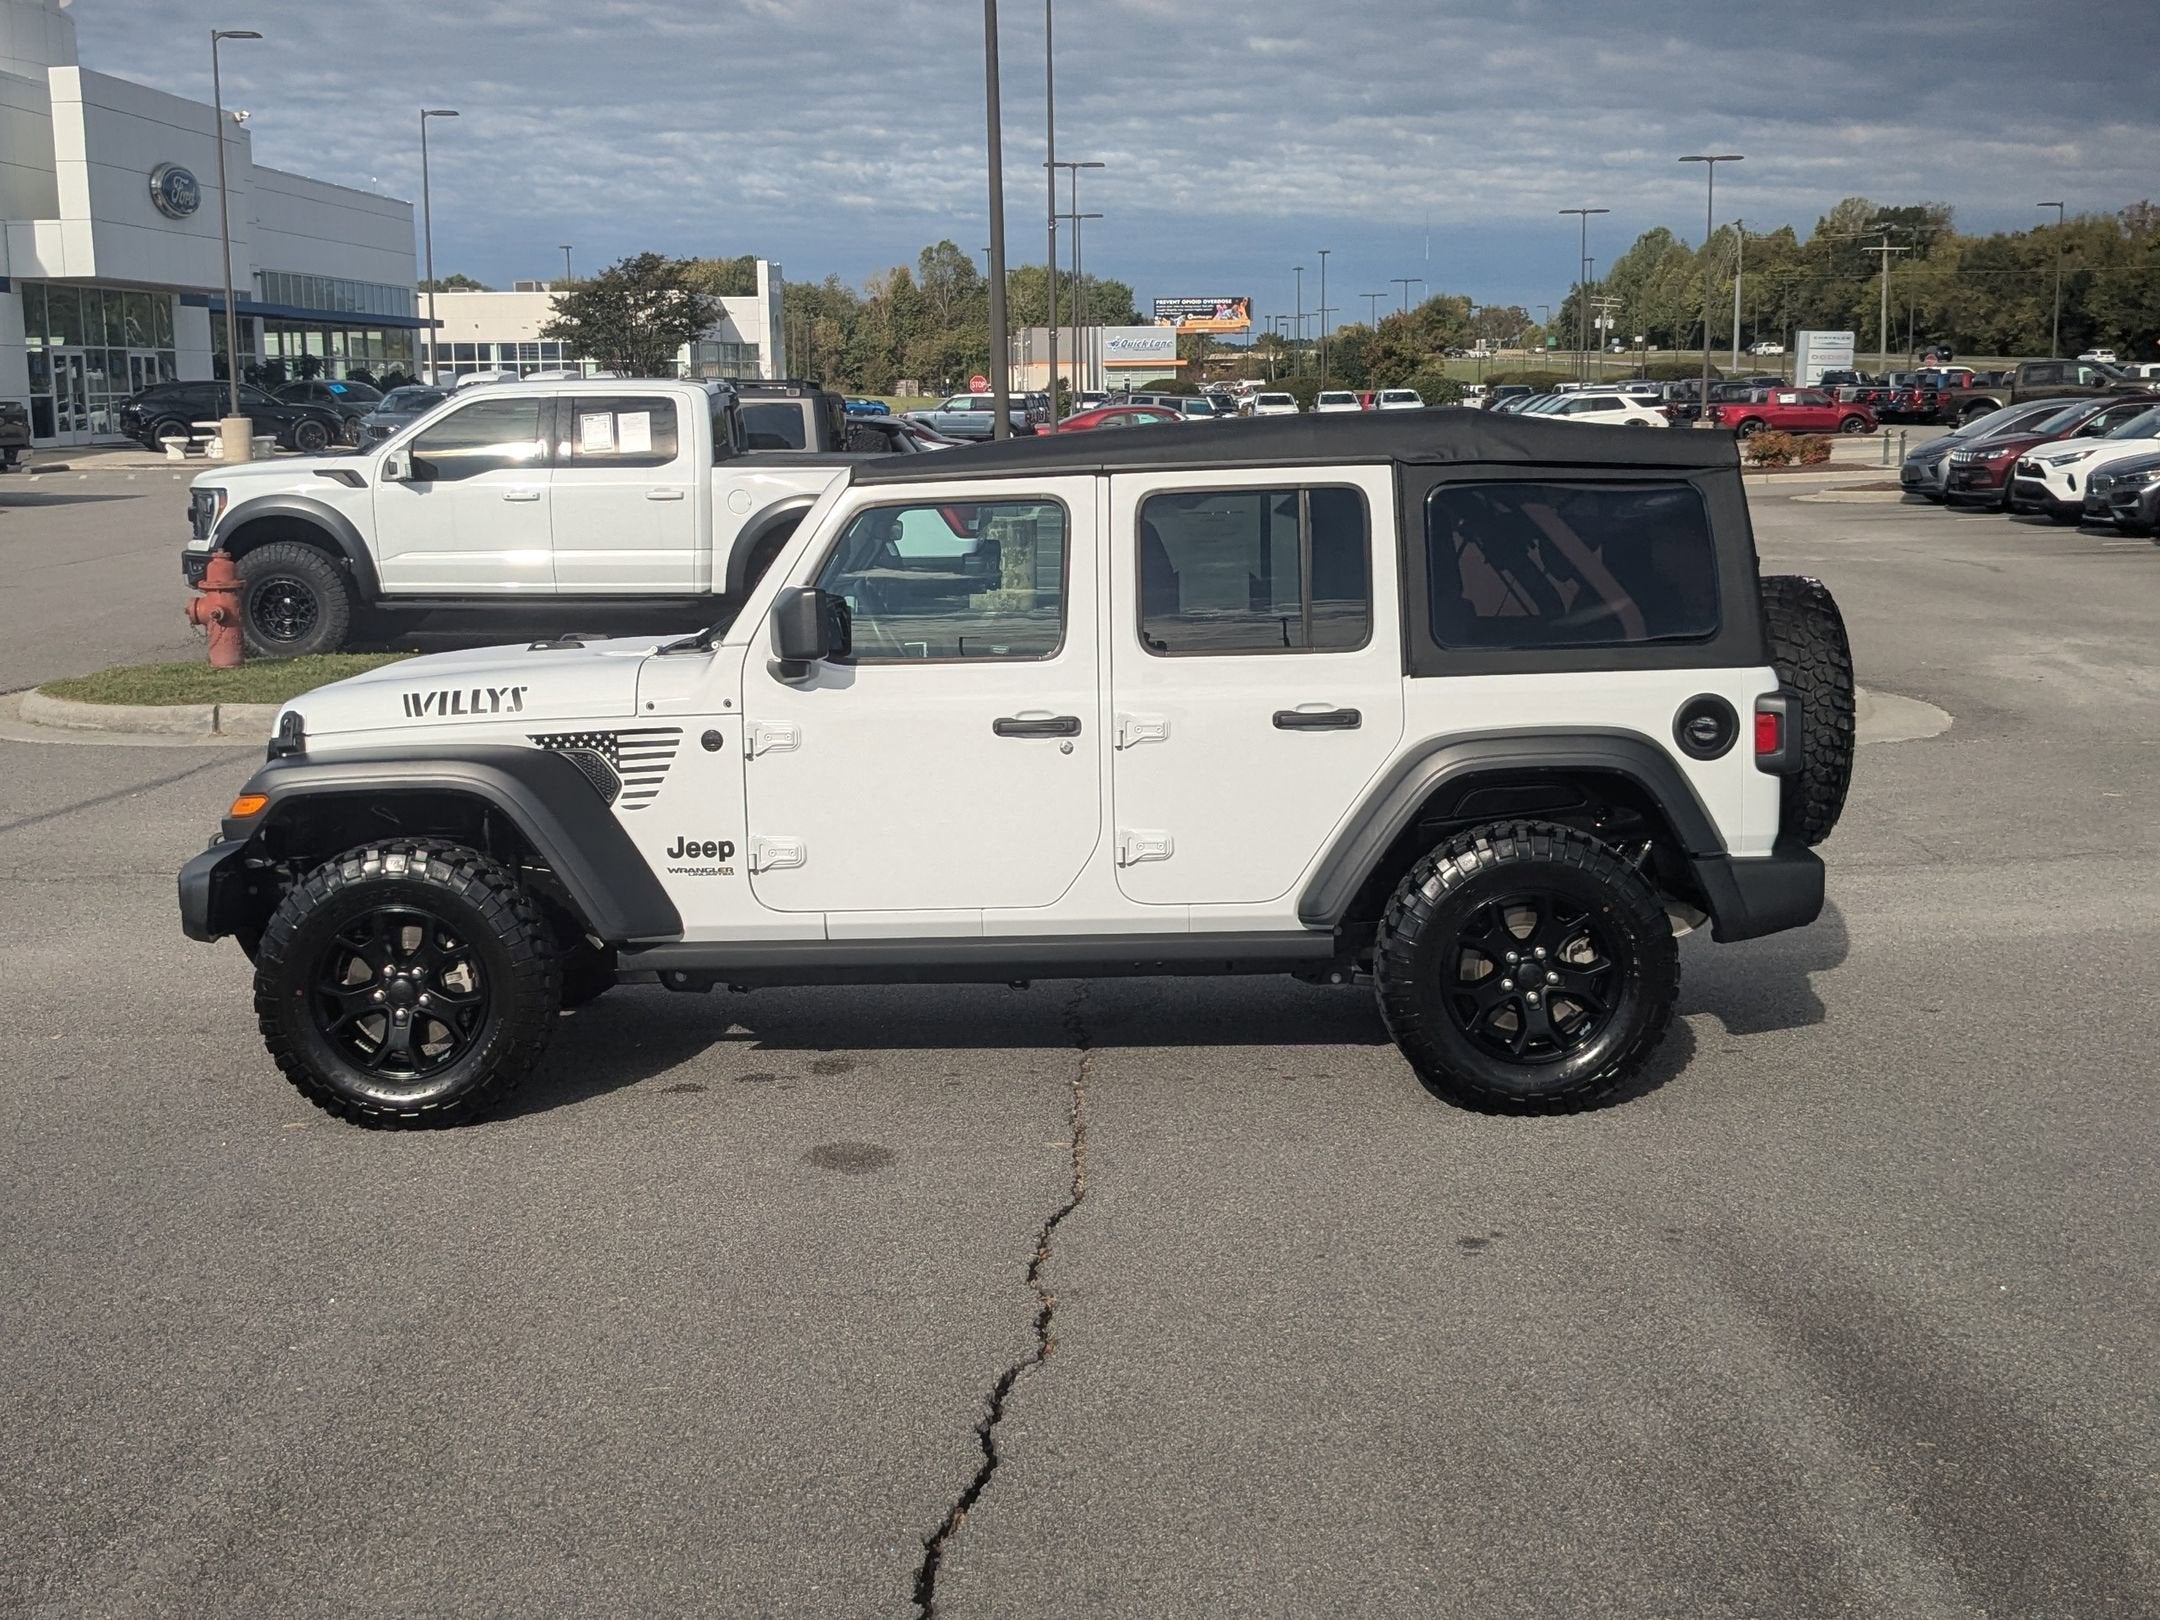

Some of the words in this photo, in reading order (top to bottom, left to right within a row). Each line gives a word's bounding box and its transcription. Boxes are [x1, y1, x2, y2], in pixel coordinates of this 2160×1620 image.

[172, 176, 195, 206] Ford
[1120, 338, 1148, 349] Quick
[1149, 338, 1173, 348] Lane
[403, 686, 528, 718] WILLYS
[666, 835, 735, 862] Jeep
